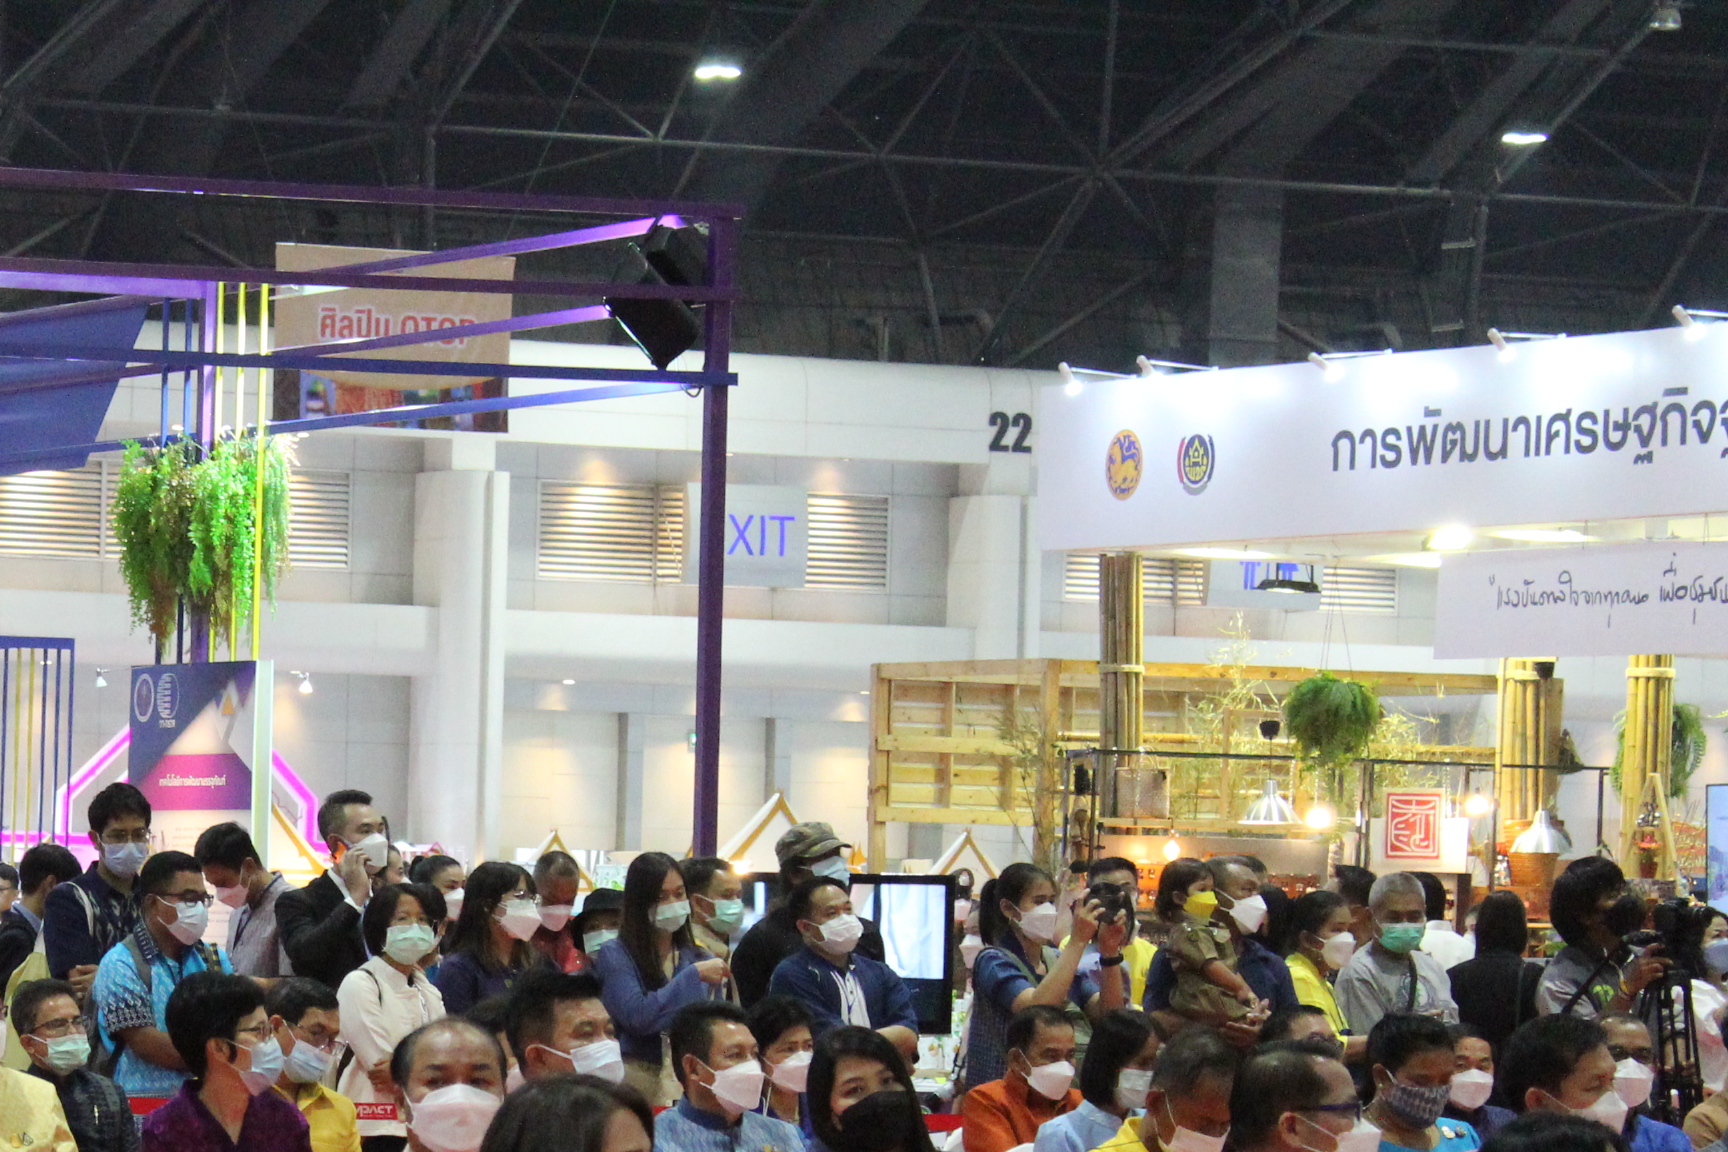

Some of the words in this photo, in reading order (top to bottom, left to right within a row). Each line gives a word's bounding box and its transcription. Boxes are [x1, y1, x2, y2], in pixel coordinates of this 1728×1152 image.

[320, 307, 391, 339] ศิลปิน
[988, 411, 1032, 453] 22
[1331, 386, 1728, 472] การพัฒนาเศรษฐกิจ
[728, 513, 795, 556] XIT
